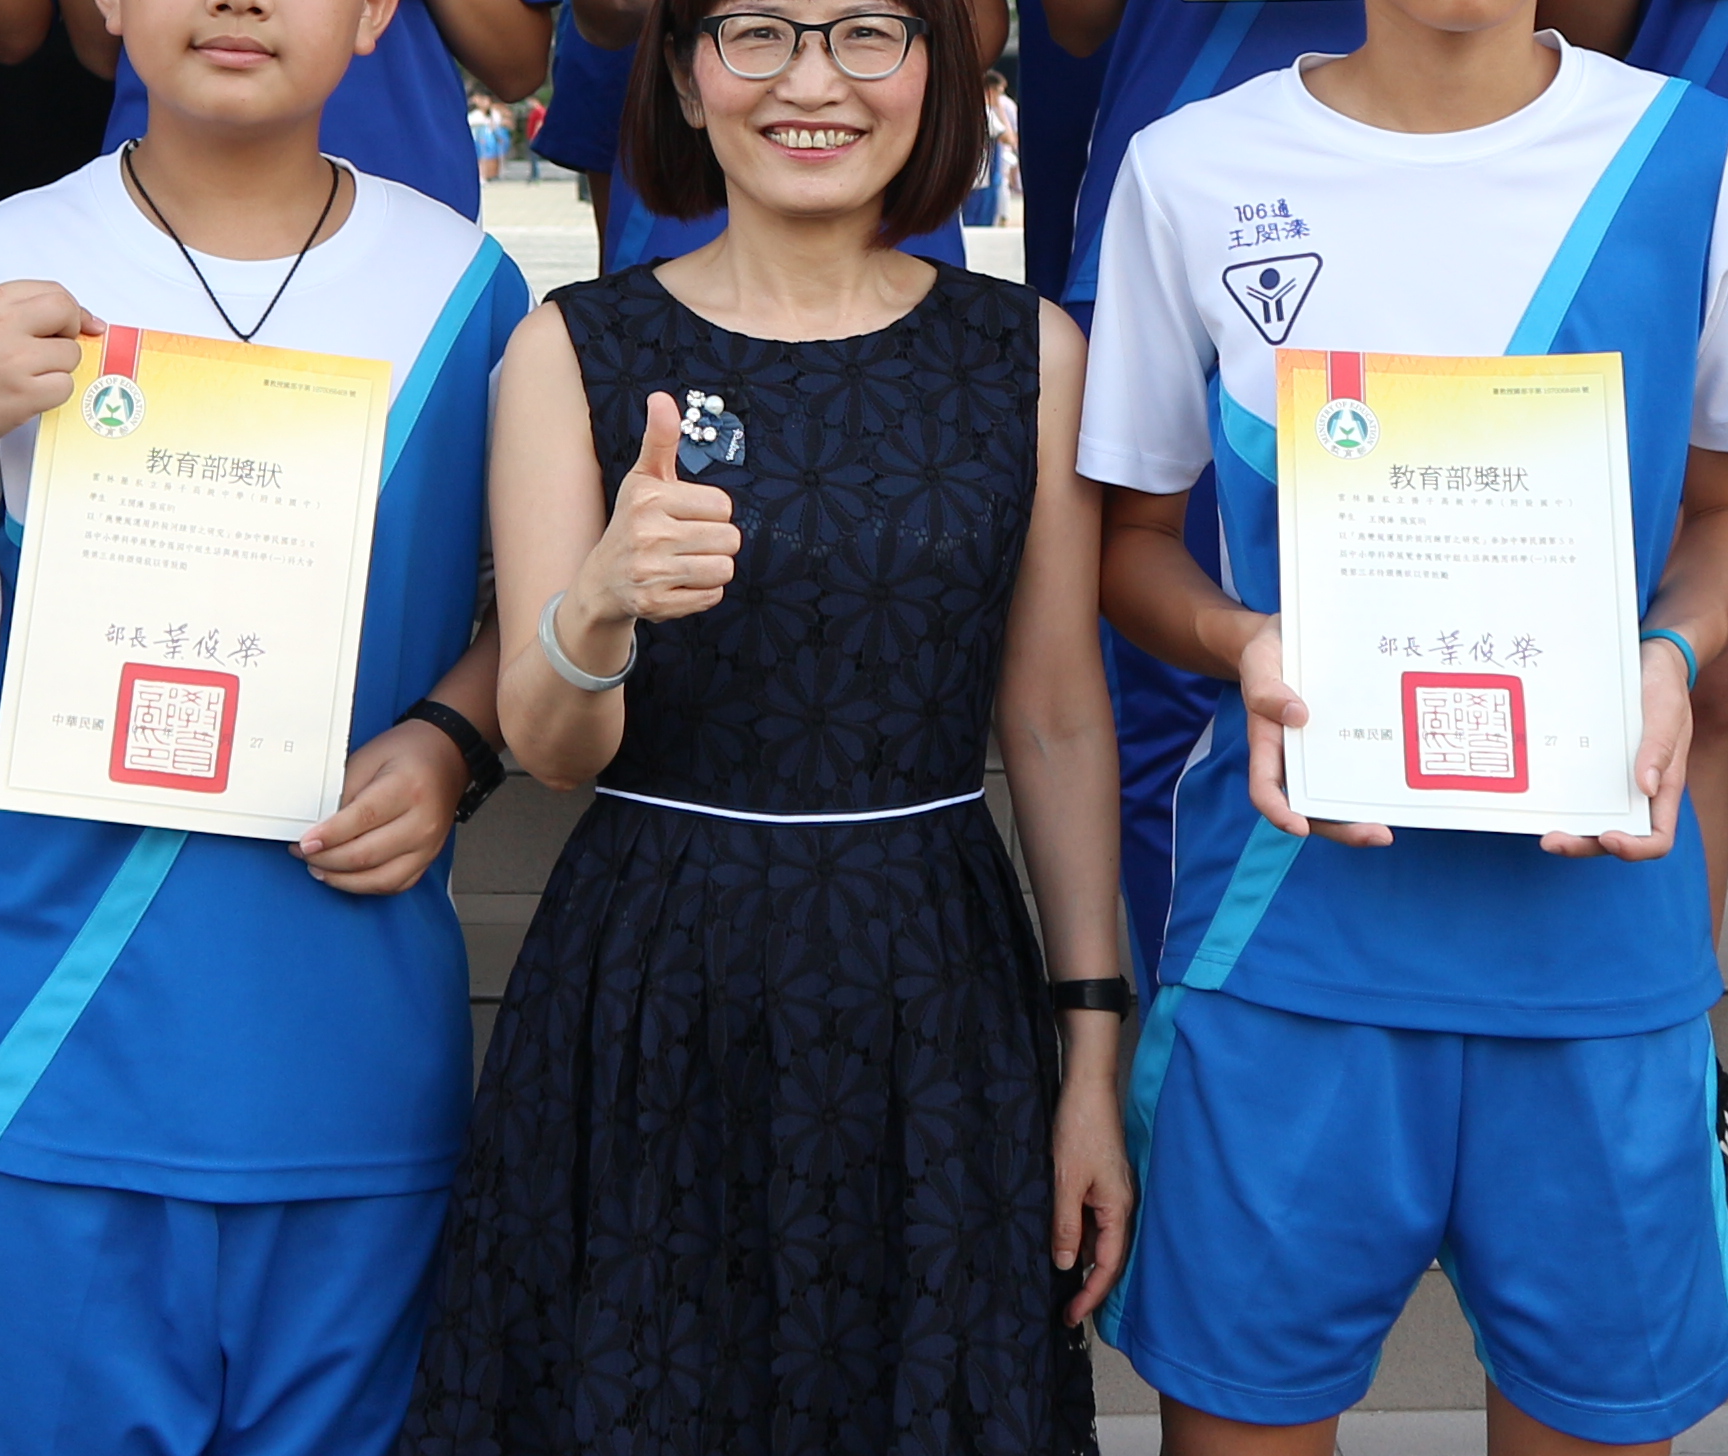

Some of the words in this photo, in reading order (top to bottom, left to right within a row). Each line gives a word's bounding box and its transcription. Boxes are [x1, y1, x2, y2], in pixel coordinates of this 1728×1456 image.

[145, 446, 284, 490] 教育部獎狀
[1388, 463, 1530, 492] 教育部獎狀
[104, 621, 266, 669] 部長葉俊榮
[1377, 629, 1544, 668] 部長葉俊榮
[52, 712, 105, 731] 中華民國
[1338, 728, 1393, 742] 中華民國
